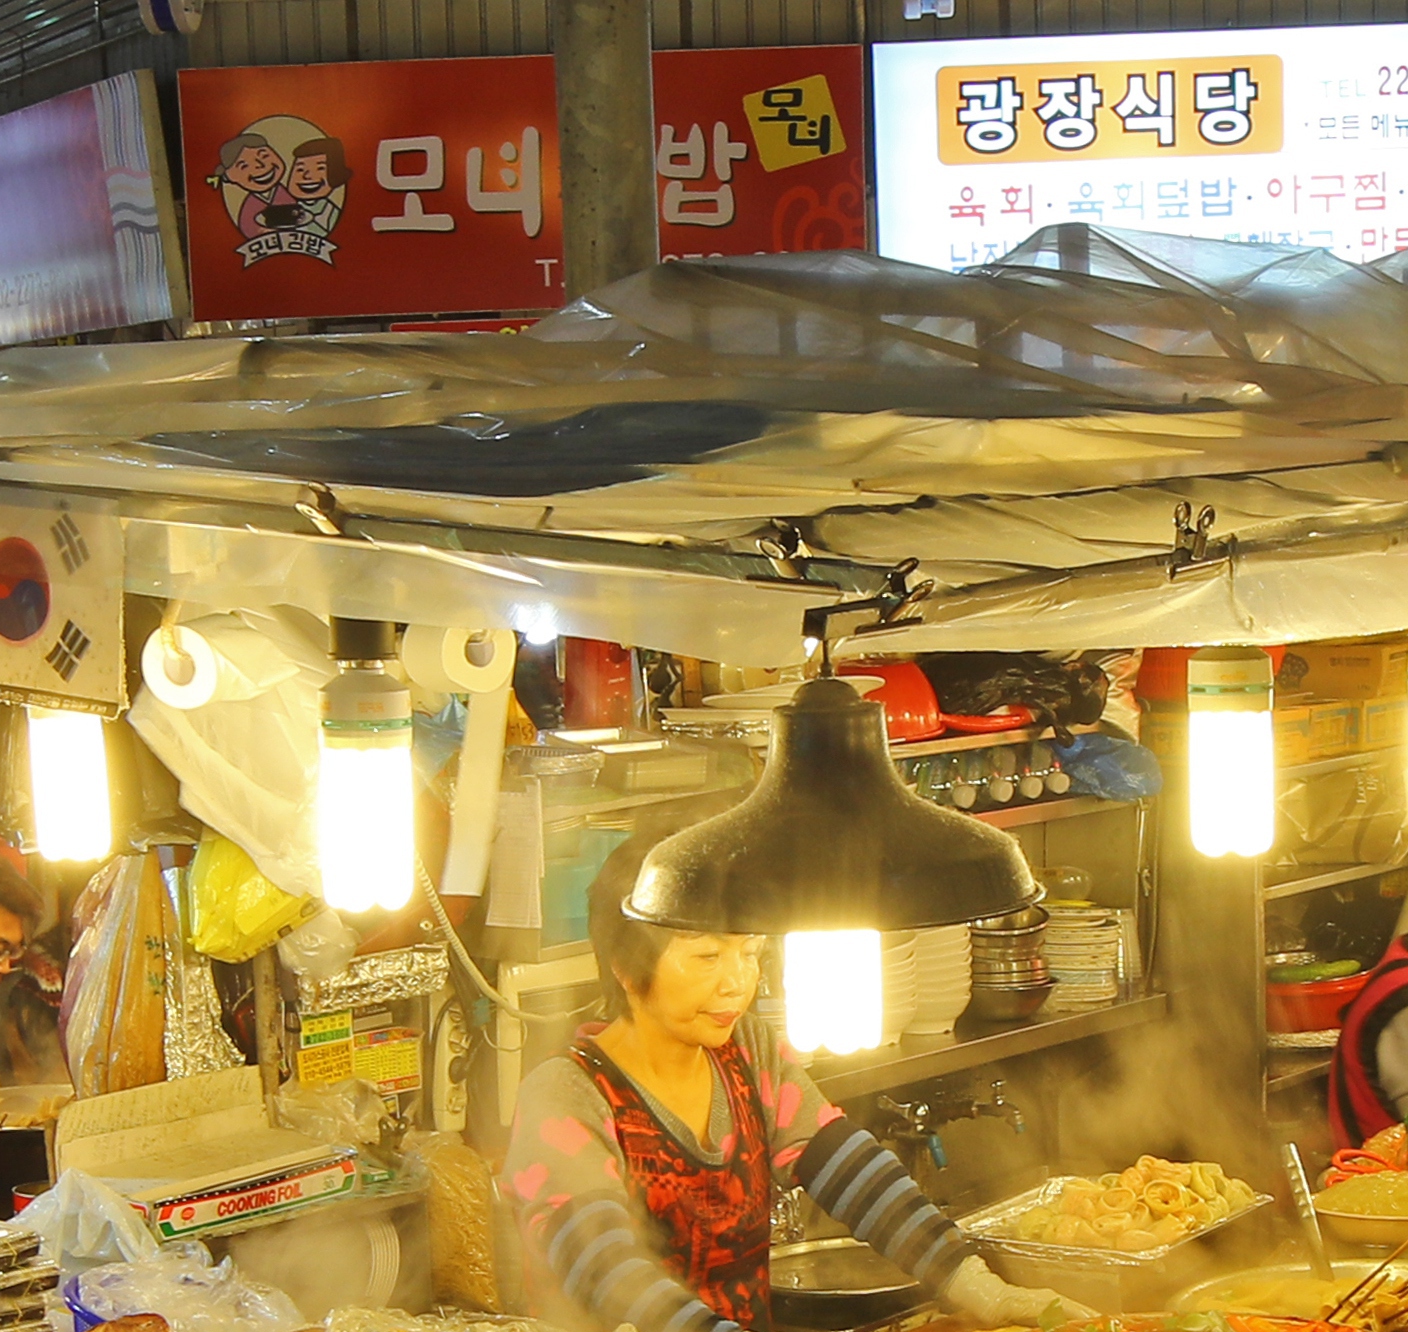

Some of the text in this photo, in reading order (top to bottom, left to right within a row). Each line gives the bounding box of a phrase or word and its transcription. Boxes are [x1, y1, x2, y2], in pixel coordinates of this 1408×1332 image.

[758, 88, 830, 155] 모녀
[956, 67, 1260, 155] 광장식당
[1319, 115, 1360, 140] 모든
[949, 184, 1033, 226] 육회
[1068, 177, 1237, 222] 육회덮밥
[1267, 171, 1386, 215] 아구찜
[248, 232, 325, 259] 모녀 김밥
[217, 1183, 303, 1217] COOKING FOIL
